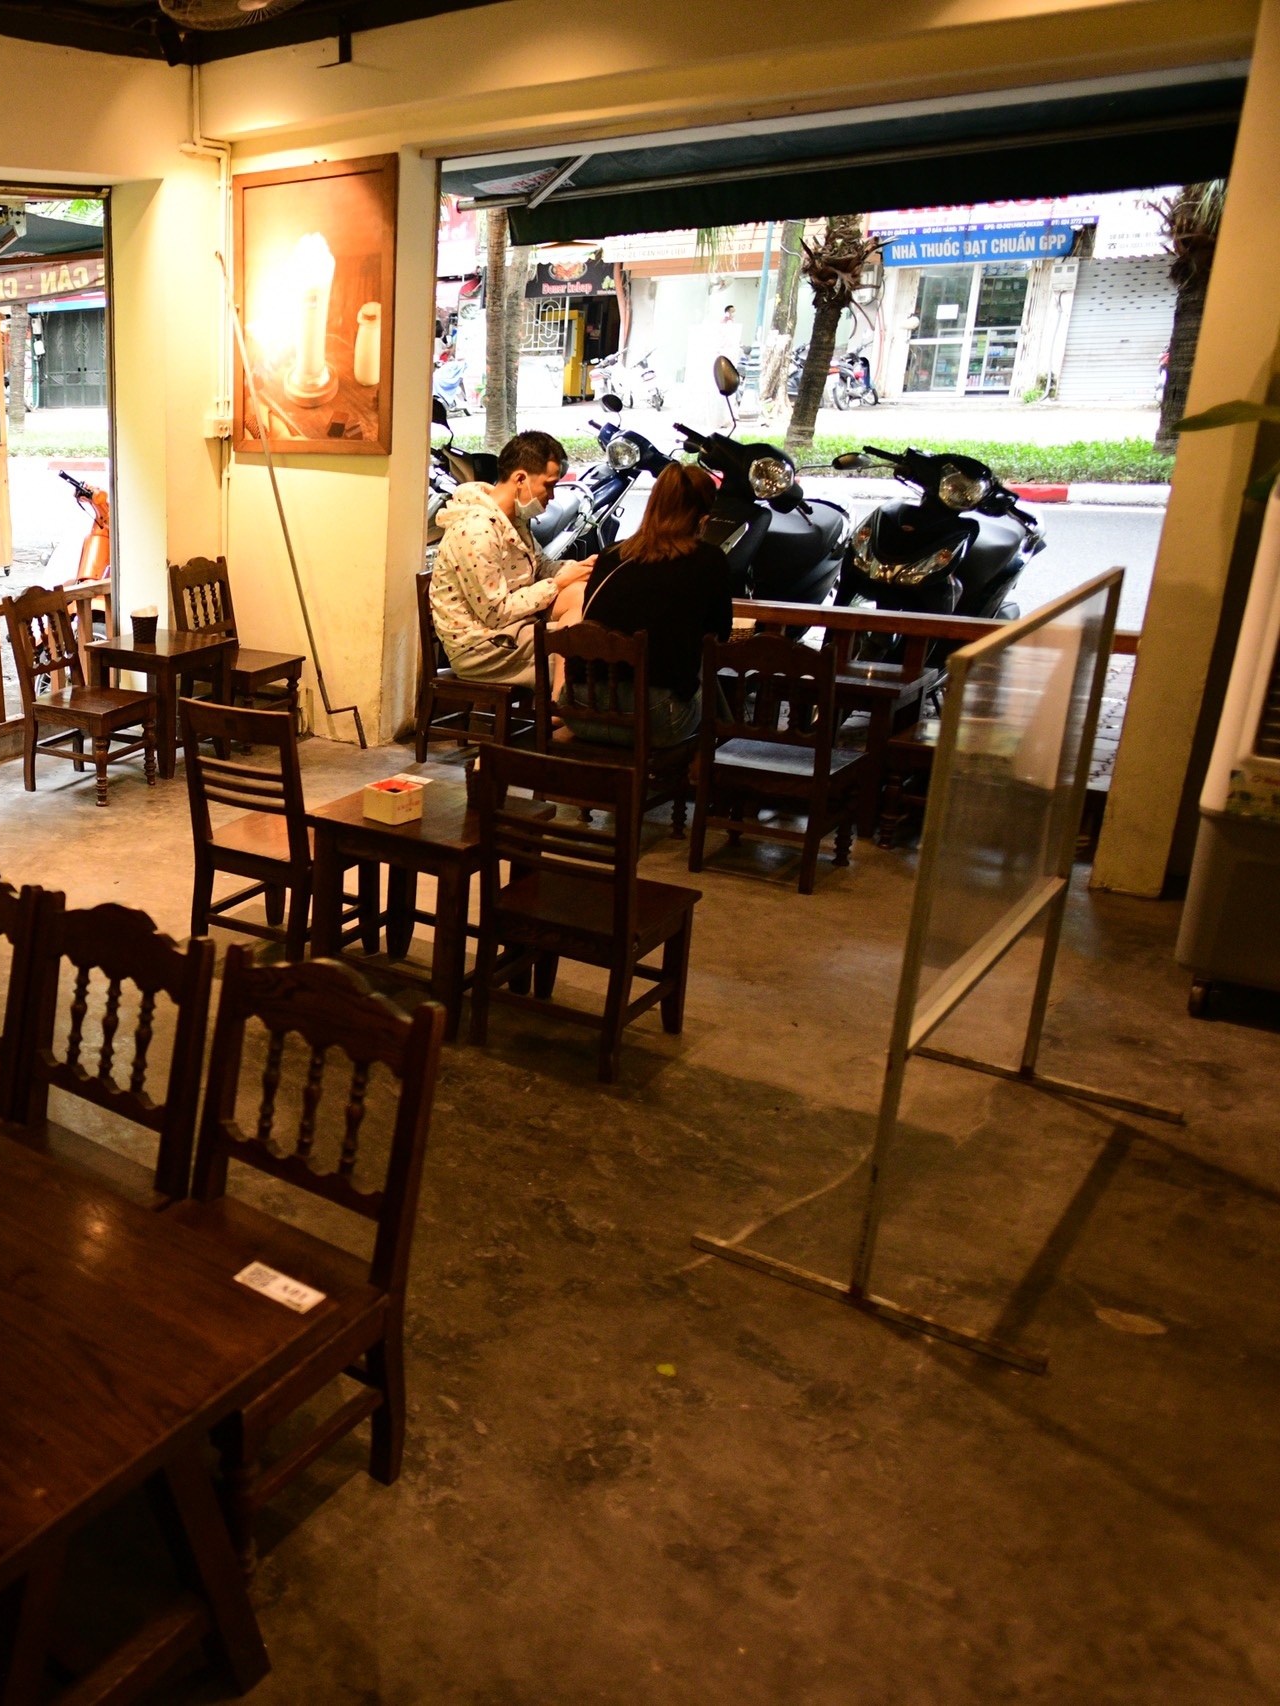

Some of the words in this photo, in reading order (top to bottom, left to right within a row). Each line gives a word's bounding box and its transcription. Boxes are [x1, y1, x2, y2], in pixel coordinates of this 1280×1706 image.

[892, 240, 917, 260] NHÀ
[920, 236, 960, 258] THUỐC
[963, 237, 987, 258] ĐẠT
[991, 230, 1035, 254] CHUẨN
[1039, 232, 1067, 252] GPP
[542, 283, 567, 295] Doner
